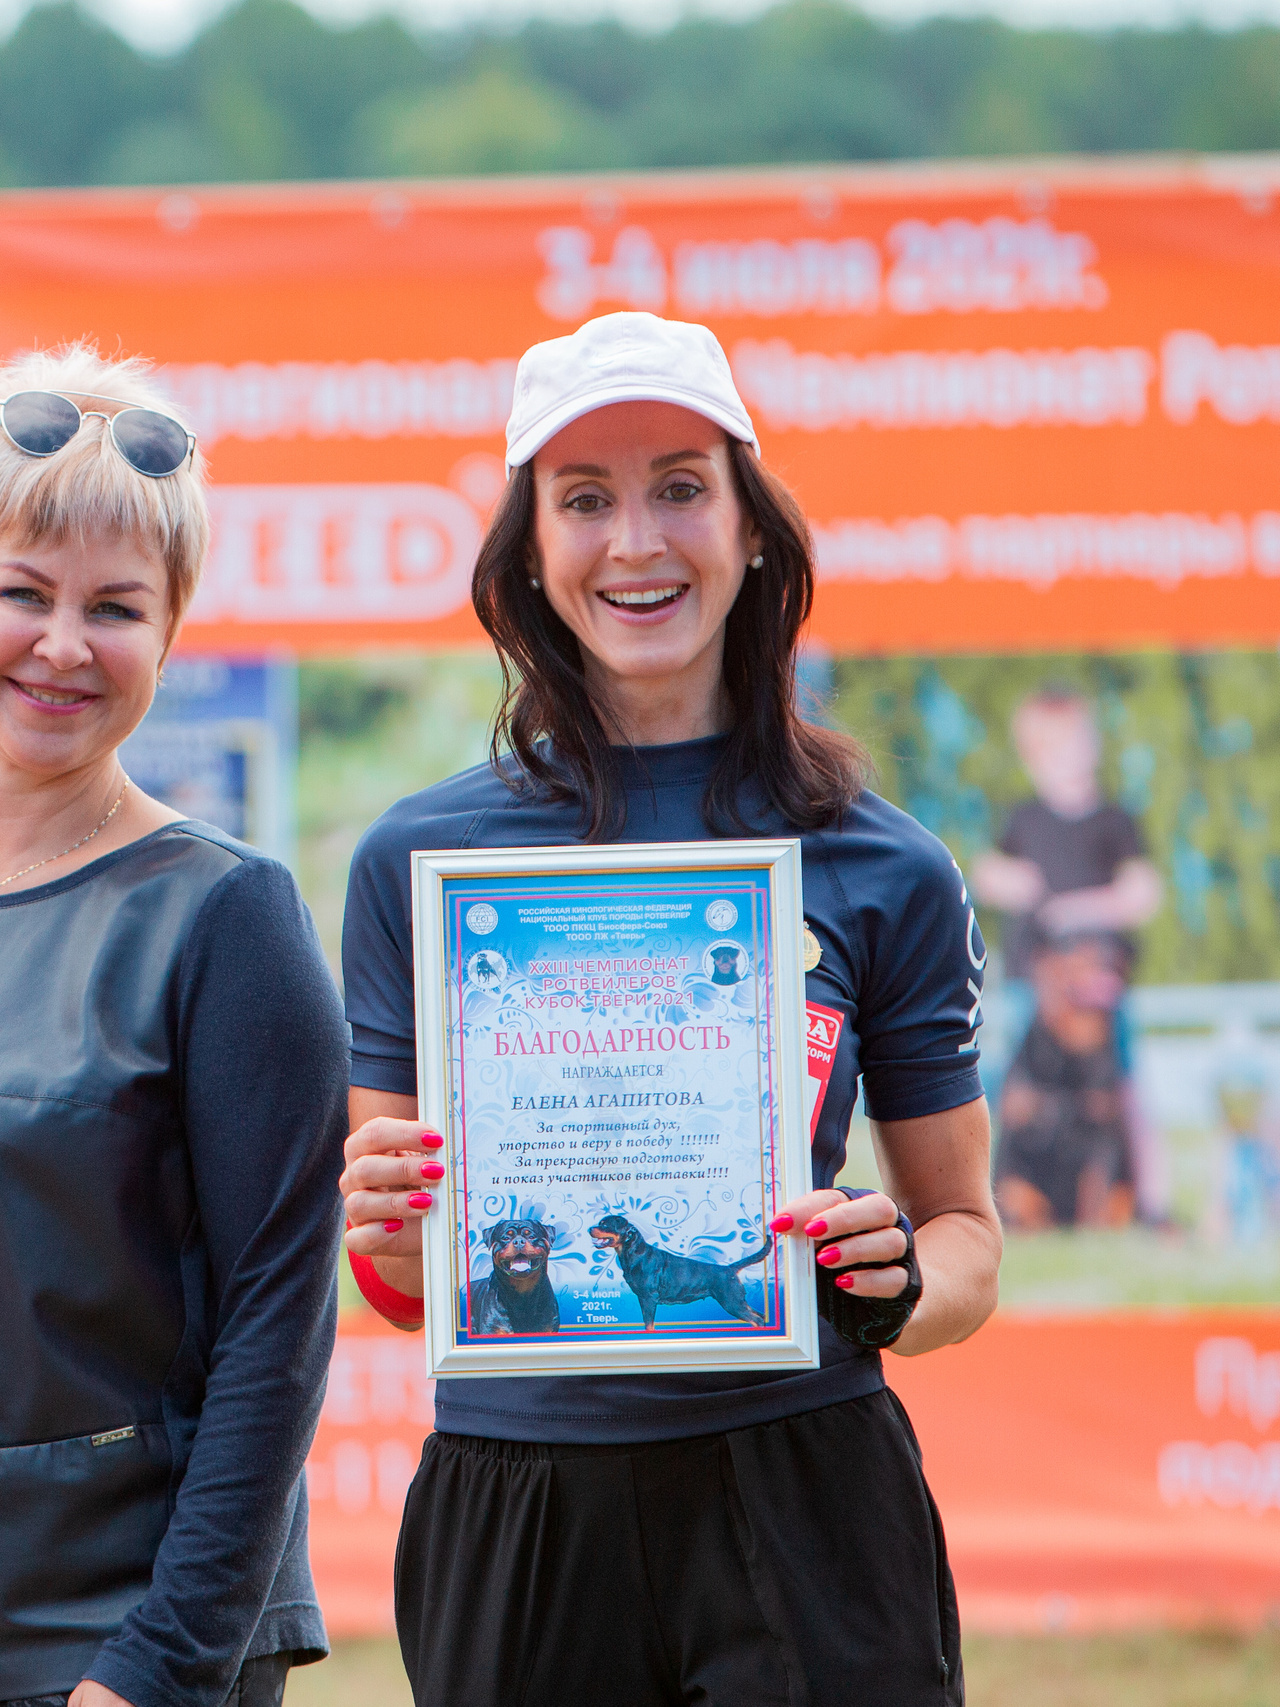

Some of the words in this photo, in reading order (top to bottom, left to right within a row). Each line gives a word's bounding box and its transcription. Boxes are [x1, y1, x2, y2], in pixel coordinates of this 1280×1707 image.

[518, 907, 570, 916] РОССИЙСКАЯ
[571, 905, 644, 914] КИНОЛОГИЧЕСКАЯ
[644, 903, 692, 912] ФЕДЕРАЦИЯ
[520, 914, 586, 924] НАЦИОНАЛЬНЫЙ
[609, 912, 643, 921] ПОРОДЫ
[644, 911, 691, 920] РОТВЕЙЛЕР
[543, 924, 570, 932] ТООО
[571, 923, 597, 932] ПККЦ
[598, 922, 668, 931] Биосфера-Союз
[565, 933, 592, 941] ТООО
[593, 932, 609, 940] ЛЖ
[610, 932, 646, 941] «Тверь»
[529, 961, 568, 974] XXIII
[574, 957, 689, 973] ЧЕМПИОНАТ
[543, 974, 676, 991] РОТВЕЙЛЕРОВ
[525, 995, 586, 1009] КУБОК
[591, 994, 648, 1007] ТВЕРИ
[653, 992, 694, 1006] 2021
[493, 1026, 730, 1059] БЛАГОДАРНОСТЬ
[561, 1064, 664, 1079] НАГРАЖДАЕТСЯ
[510, 1095, 580, 1110] ЕЛЕНА
[583, 1091, 705, 1108] АГАПИТОВА
[536, 1122, 554, 1133] За
[561, 1120, 650, 1135] спортивный
[653, 1118, 681, 1132] дух,
[497, 1140, 565, 1155] упорство
[569, 1141, 578, 1150] и
[581, 1139, 611, 1152] веру
[615, 1139, 622, 1148] в
[626, 1135, 673, 1149] победу
[514, 1155, 532, 1168] За
[535, 1154, 618, 1170] прекрасную
[622, 1152, 705, 1167] подготовку
[491, 1175, 500, 1185] и
[503, 1175, 544, 1184] показ
[546, 1171, 632, 1187] участников
[635, 1167, 729, 1181] выставки!!!!
[572, 1290, 589, 1299] 3-4
[581, 1301, 613, 1311] 2021г.
[576, 1315, 584, 1323] г.
[585, 1313, 619, 1324] Тверь
